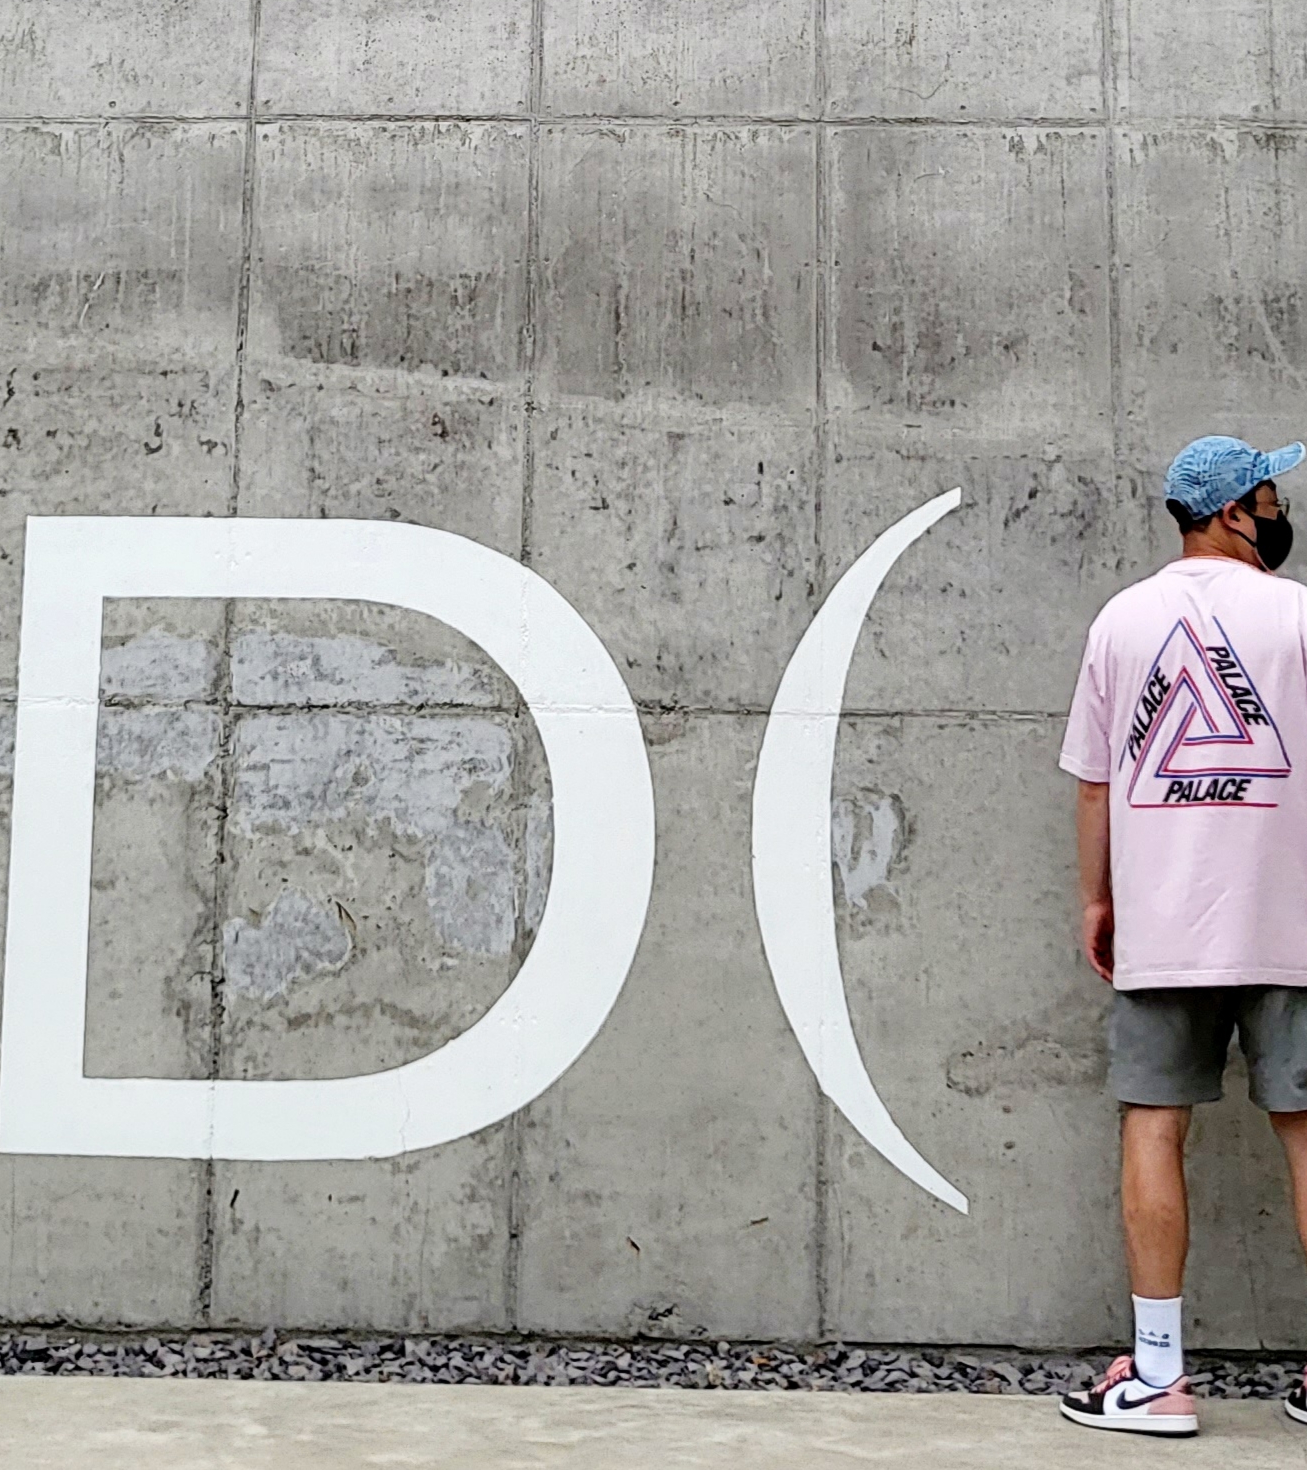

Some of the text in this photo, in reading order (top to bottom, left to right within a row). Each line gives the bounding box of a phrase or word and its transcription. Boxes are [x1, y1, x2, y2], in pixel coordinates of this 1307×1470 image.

[1127, 666, 1171, 762] PALACE
[1205, 646, 1270, 726] PALACE
[1162, 778, 1252, 803] PALACE
